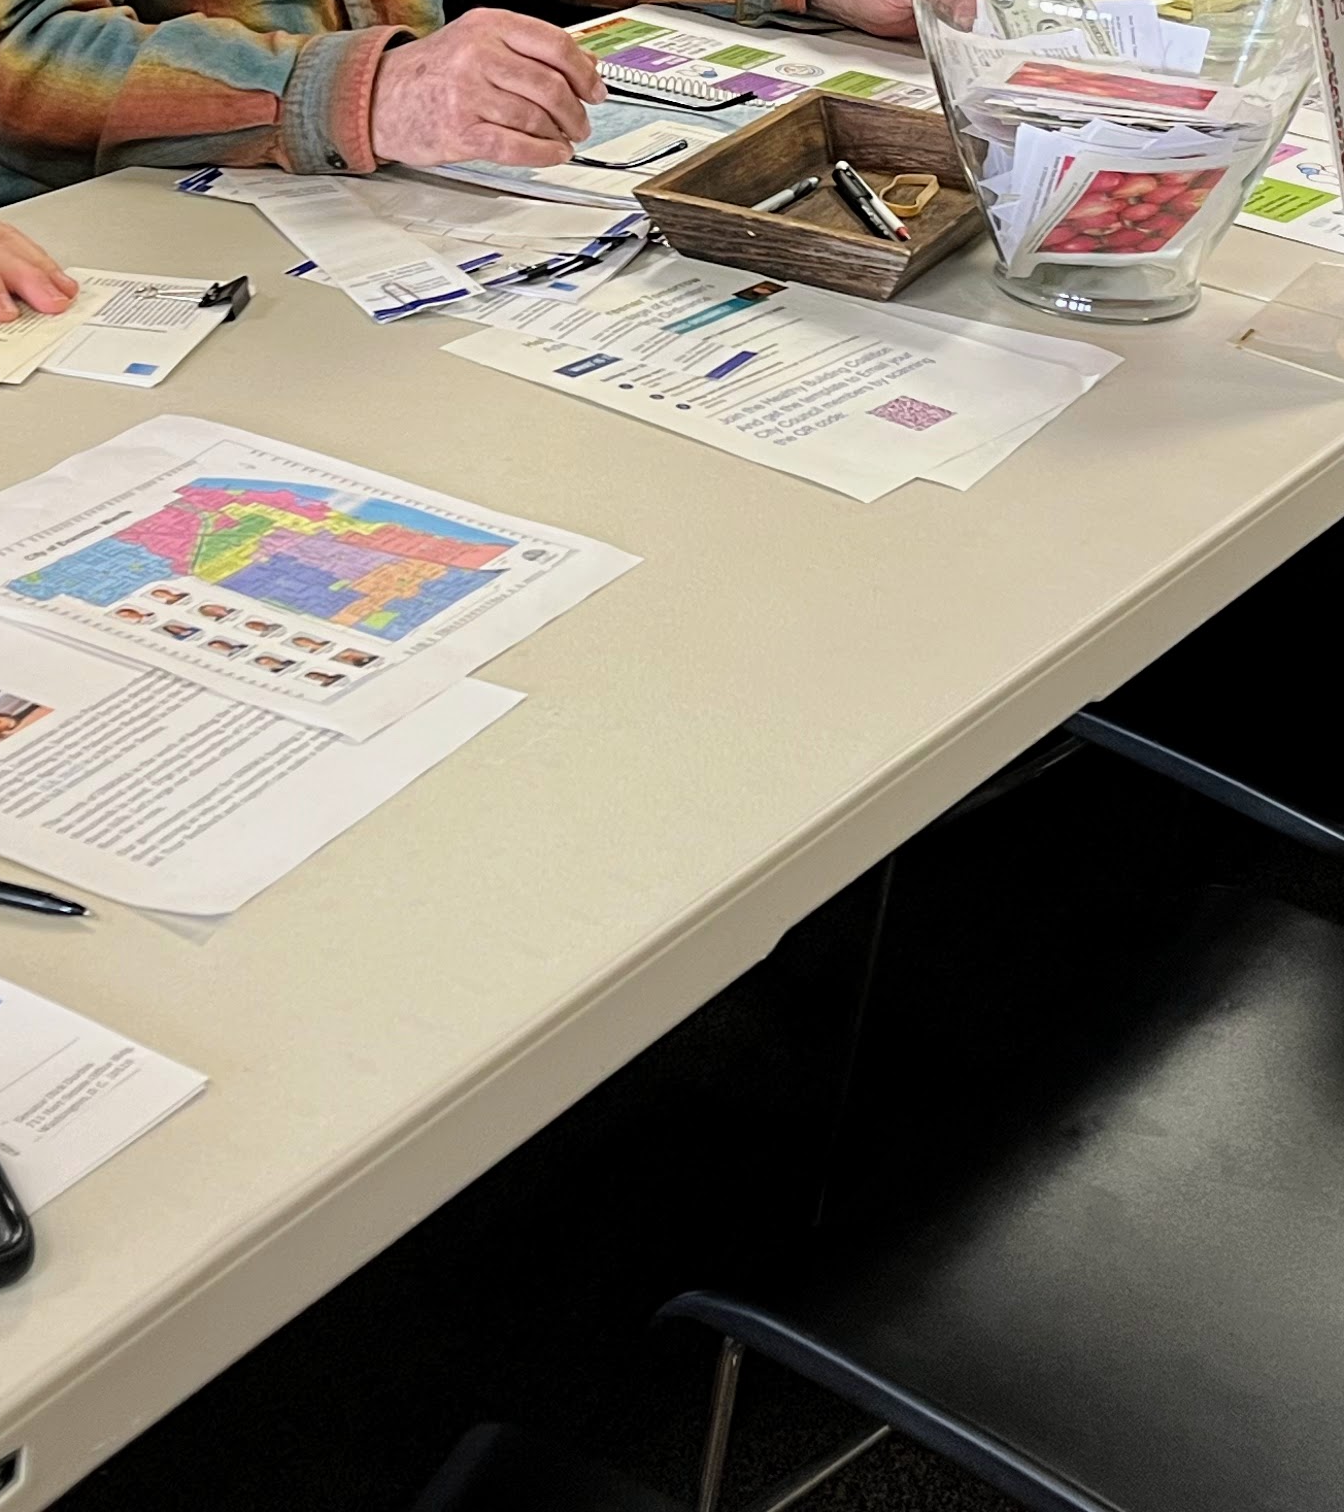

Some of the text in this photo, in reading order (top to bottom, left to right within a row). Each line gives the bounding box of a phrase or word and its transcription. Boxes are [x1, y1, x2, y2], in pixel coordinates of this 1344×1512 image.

[719, 346, 896, 426] Join the Healthy Building Coalition
[737, 351, 913, 433] And get the template to Email your
[753, 357, 937, 440] City Council members by scanning
[773, 435, 797, 447] the
[794, 425, 818, 438] QR
